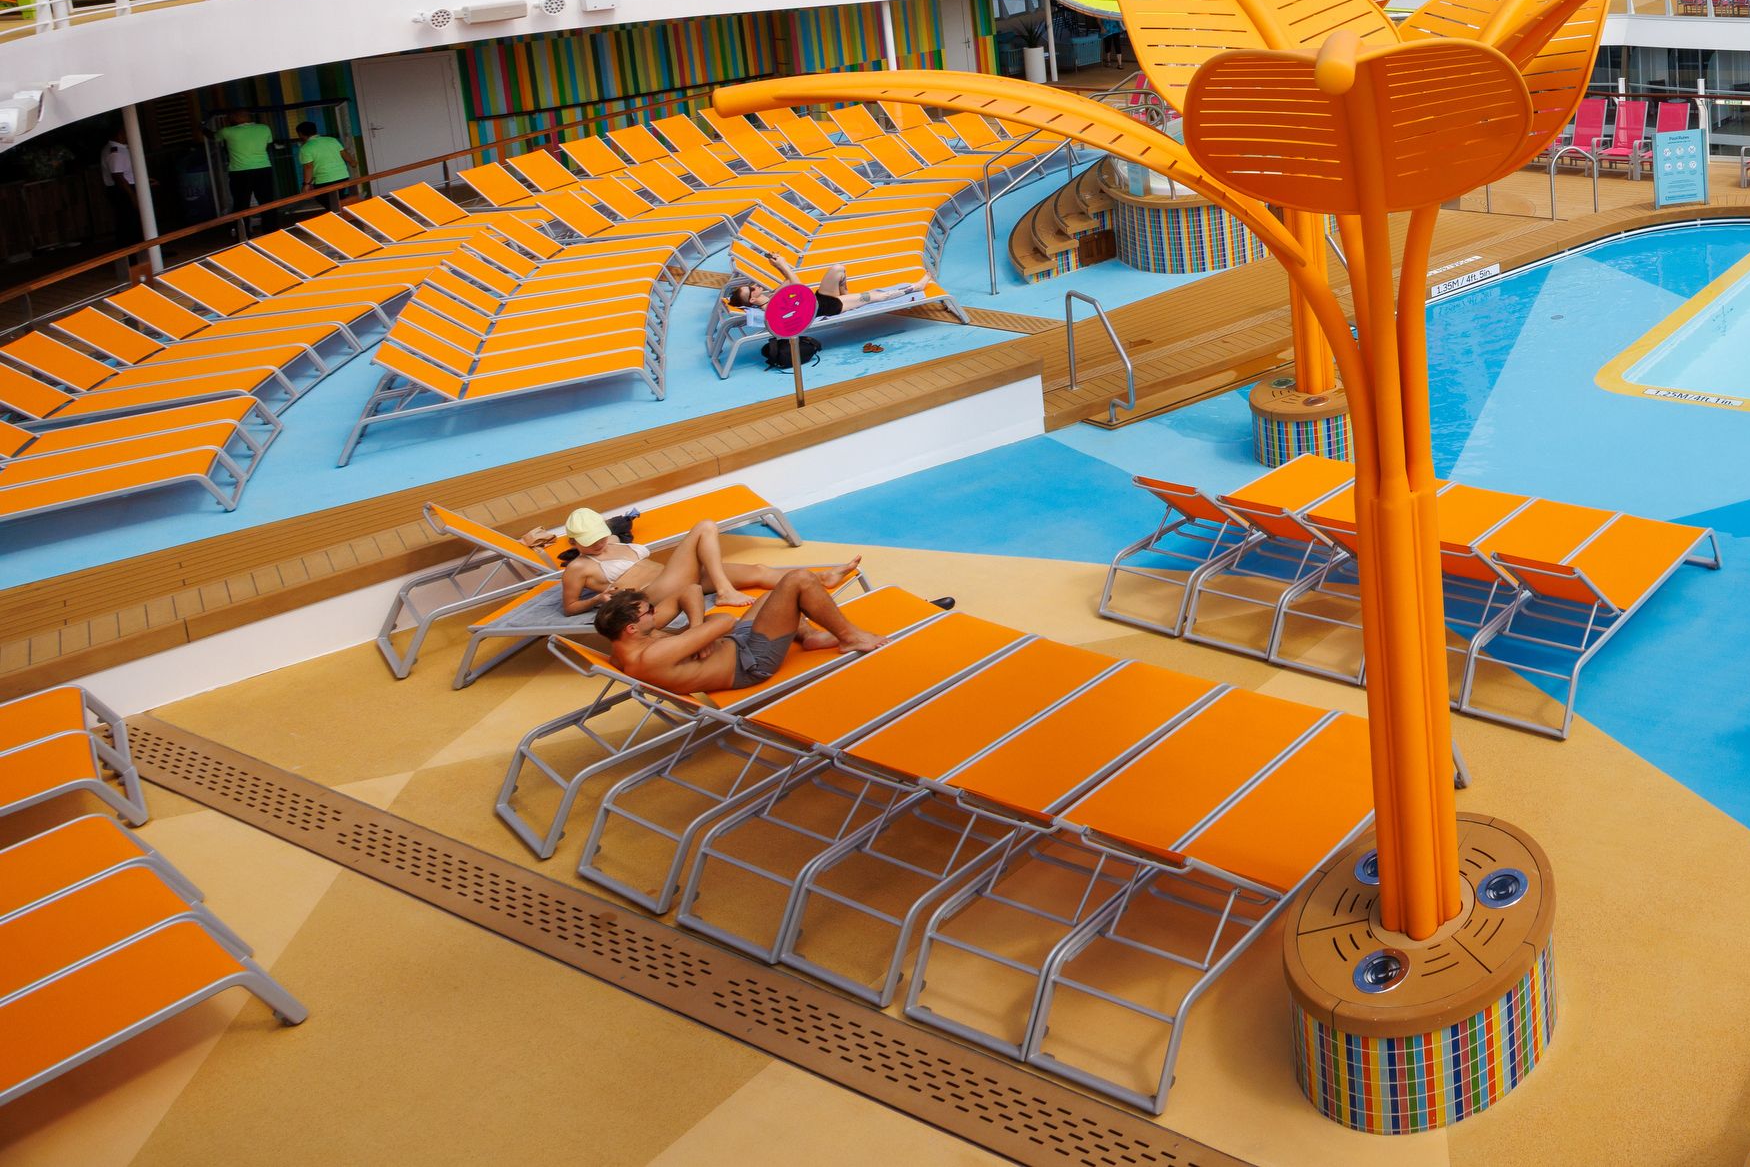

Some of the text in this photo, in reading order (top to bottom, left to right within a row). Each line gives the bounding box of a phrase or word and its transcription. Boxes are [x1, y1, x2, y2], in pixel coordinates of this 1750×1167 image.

[1437, 279, 1460, 294] 1.35M
[1466, 273, 1478, 283] 4ft.
[1479, 269, 1492, 279] 5in.
